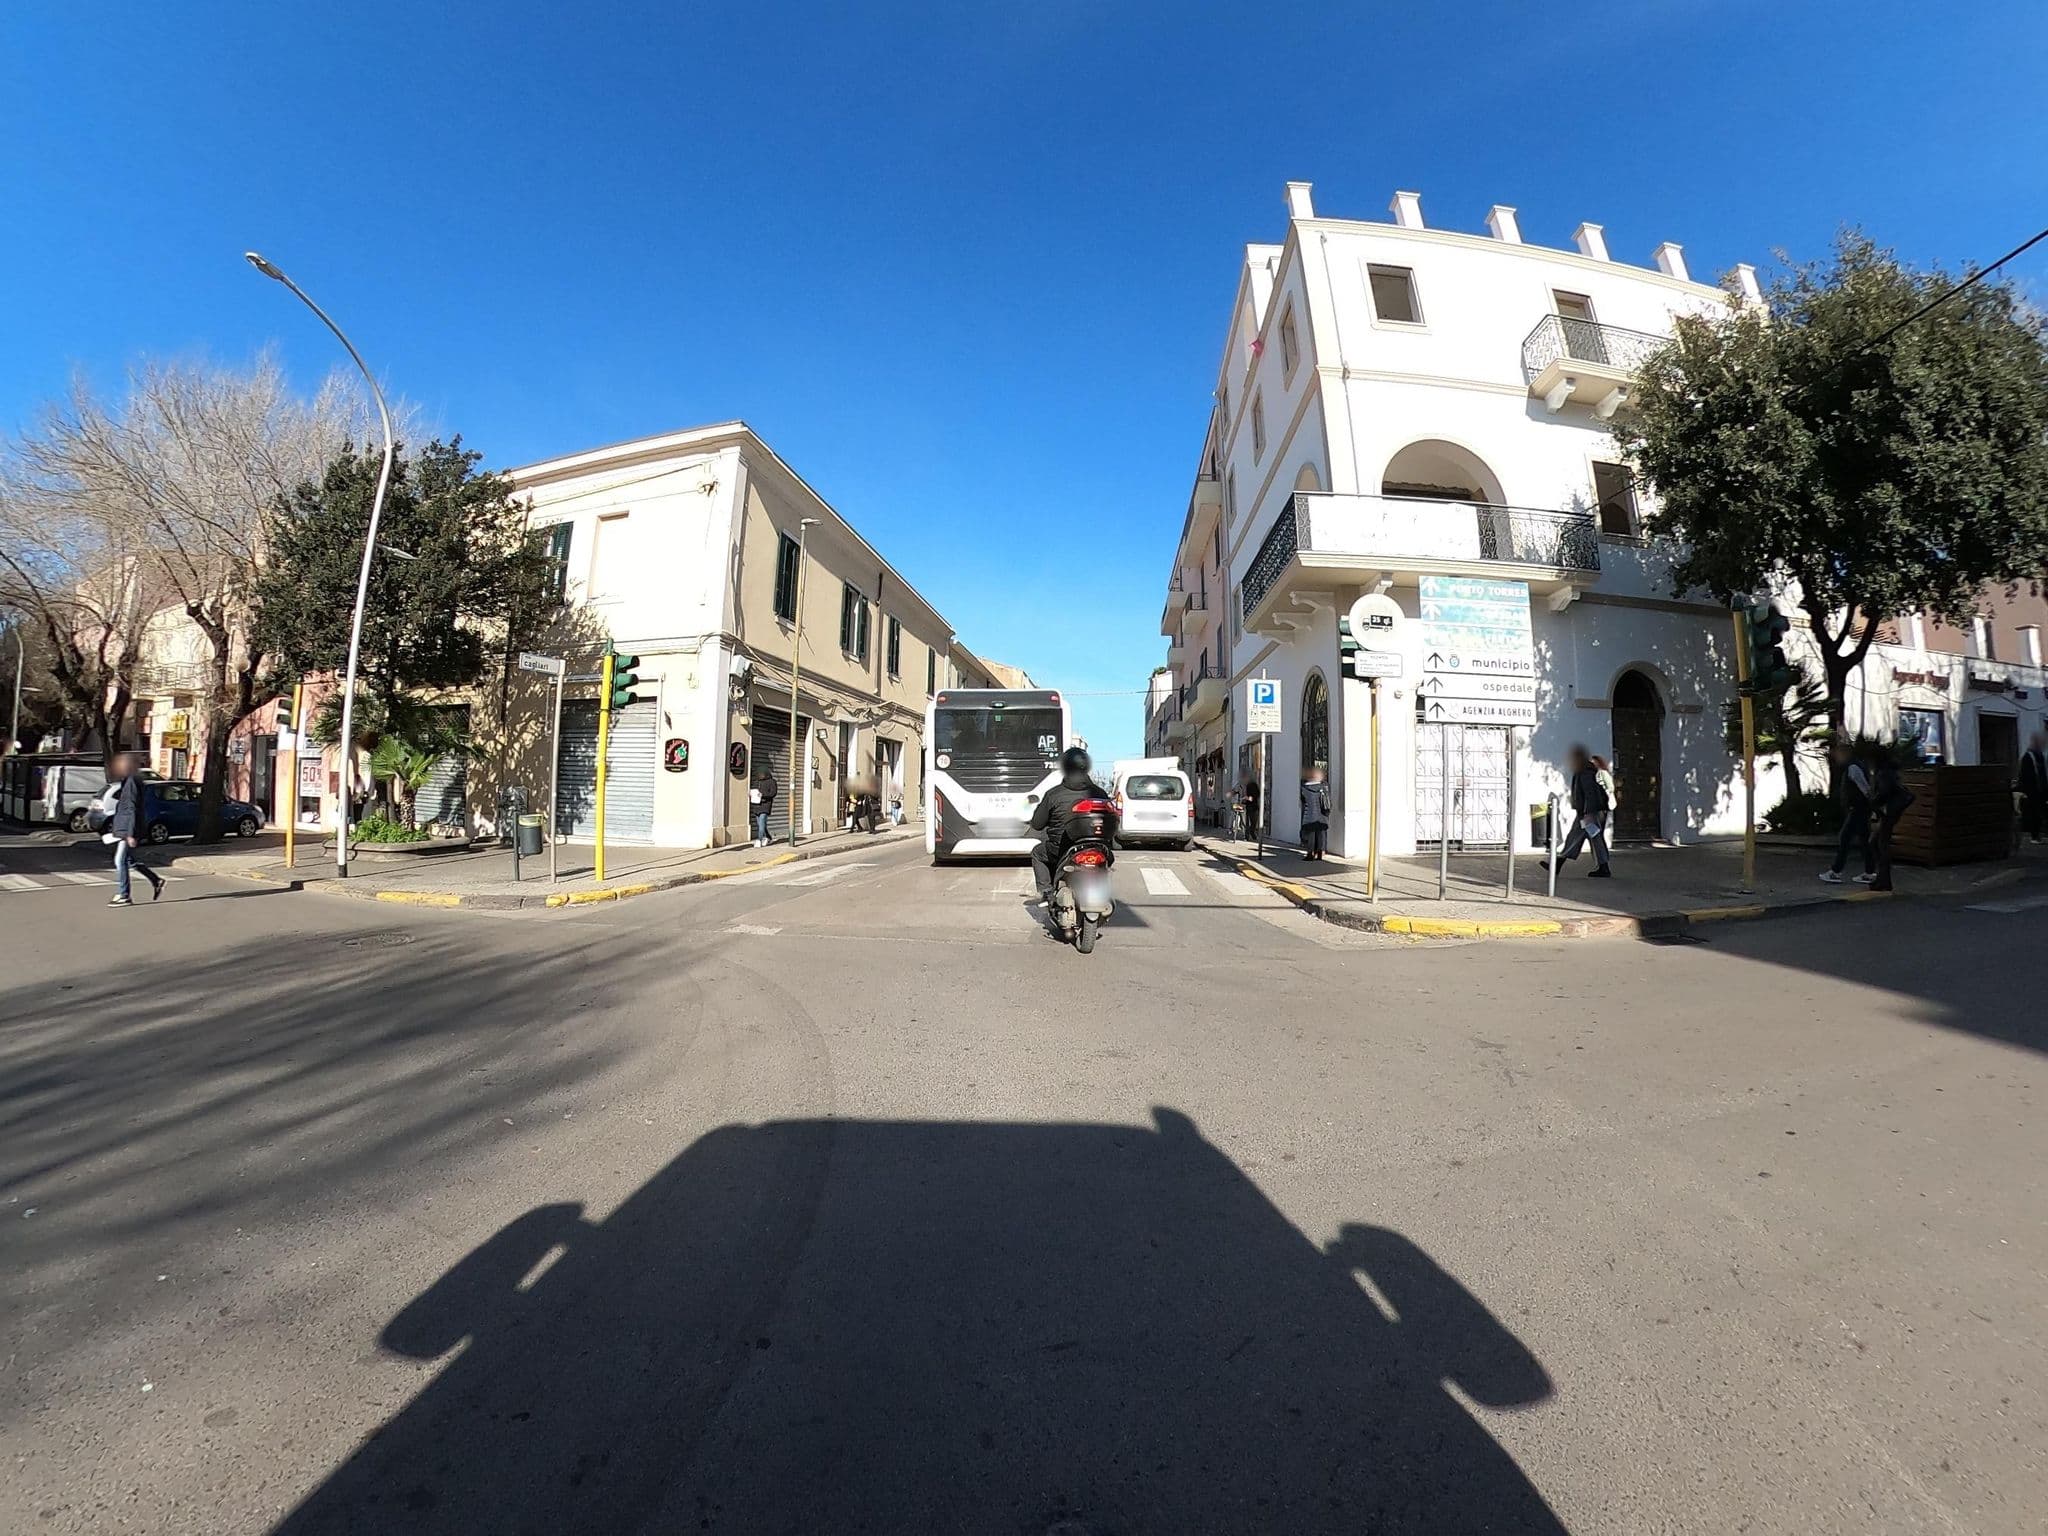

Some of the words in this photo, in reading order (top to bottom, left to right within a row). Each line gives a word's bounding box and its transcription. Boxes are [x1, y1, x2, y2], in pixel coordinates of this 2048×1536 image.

[1472, 659, 1530, 671] municipio
[1258, 685, 1271, 702] P
[1482, 683, 1533, 693] ospedale
[1462, 706, 1495, 716] AGENZIA
[1498, 707, 1532, 718] ALGHERO
[1037, 735, 1056, 748] AP
